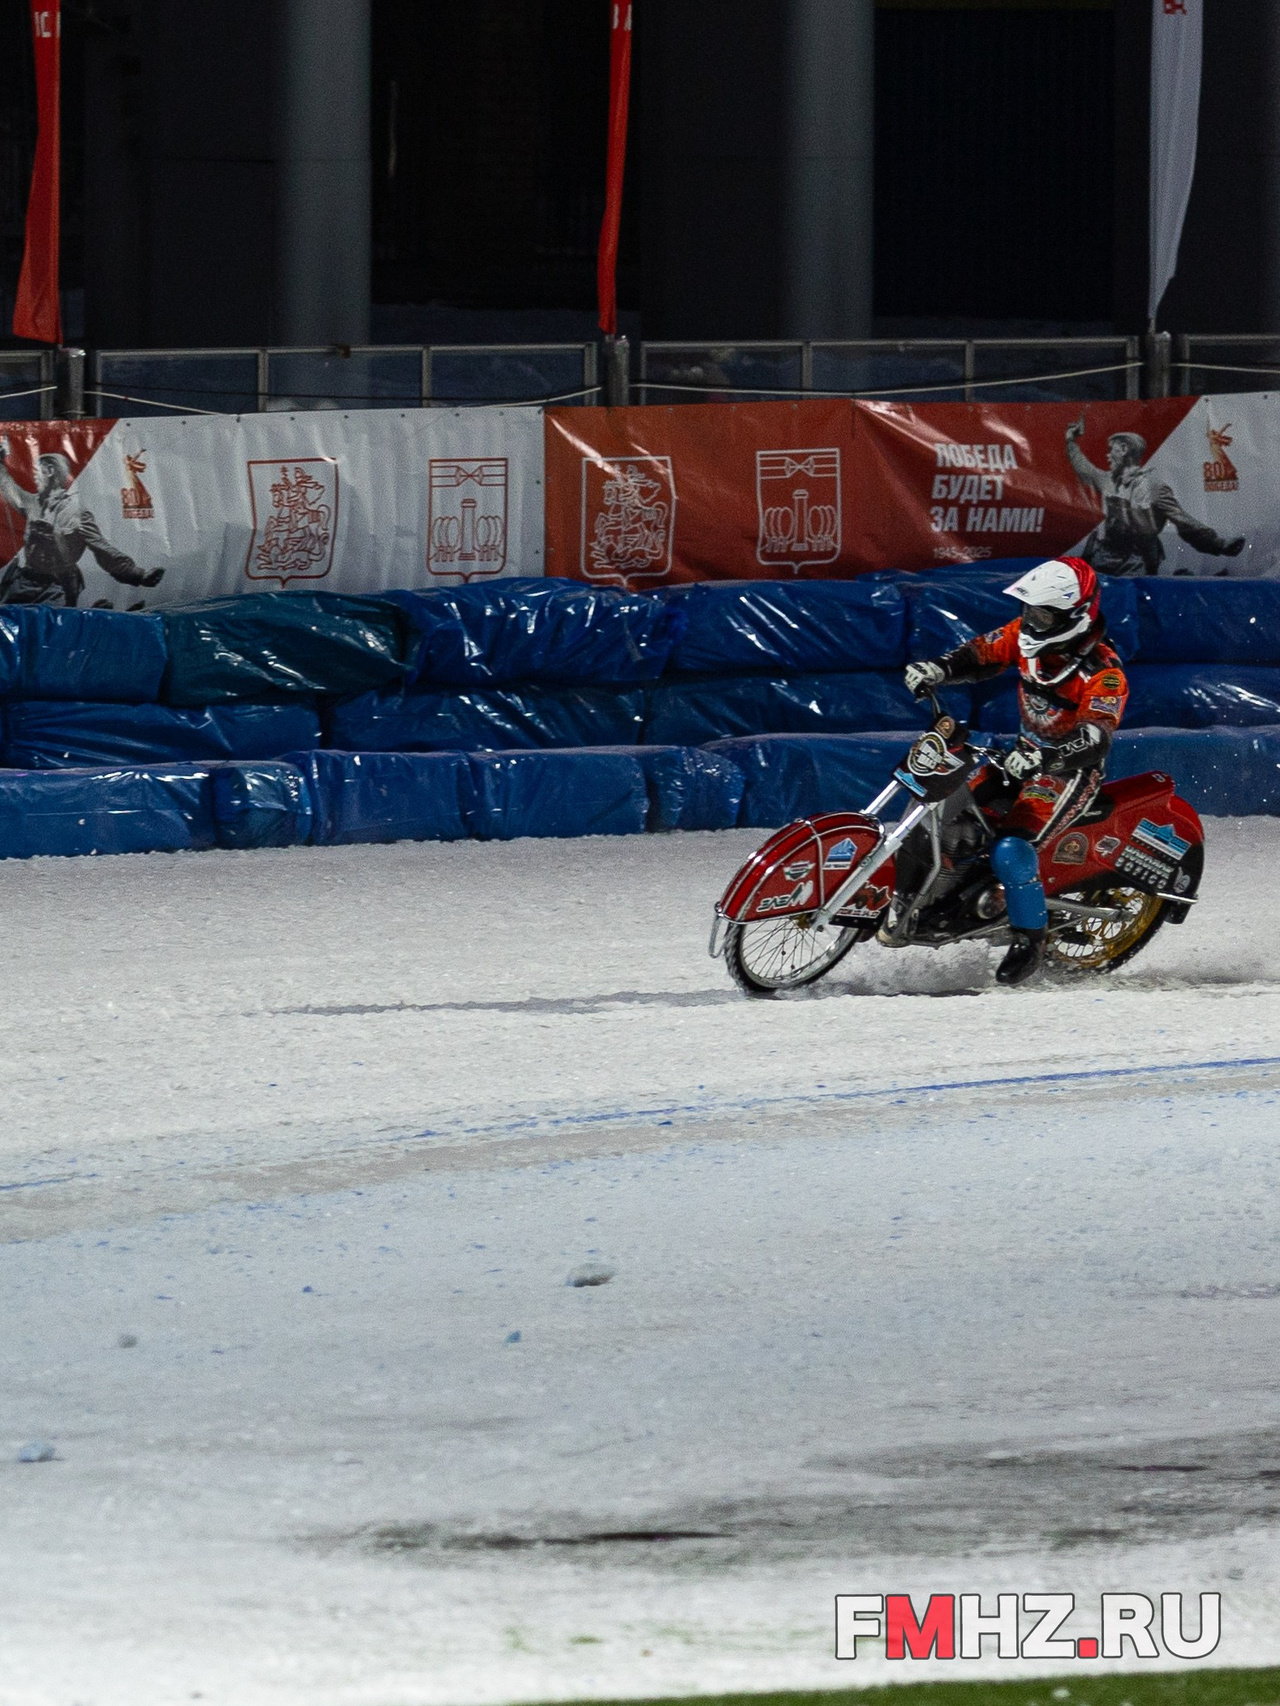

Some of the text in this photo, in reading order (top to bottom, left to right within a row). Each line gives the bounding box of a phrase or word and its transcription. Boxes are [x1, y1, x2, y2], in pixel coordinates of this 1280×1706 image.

[934, 443, 1019, 473] ПОБЕДА
[931, 474, 1005, 505] БУДЕТ
[930, 506, 1045, 533] ЗА НАМИ!
